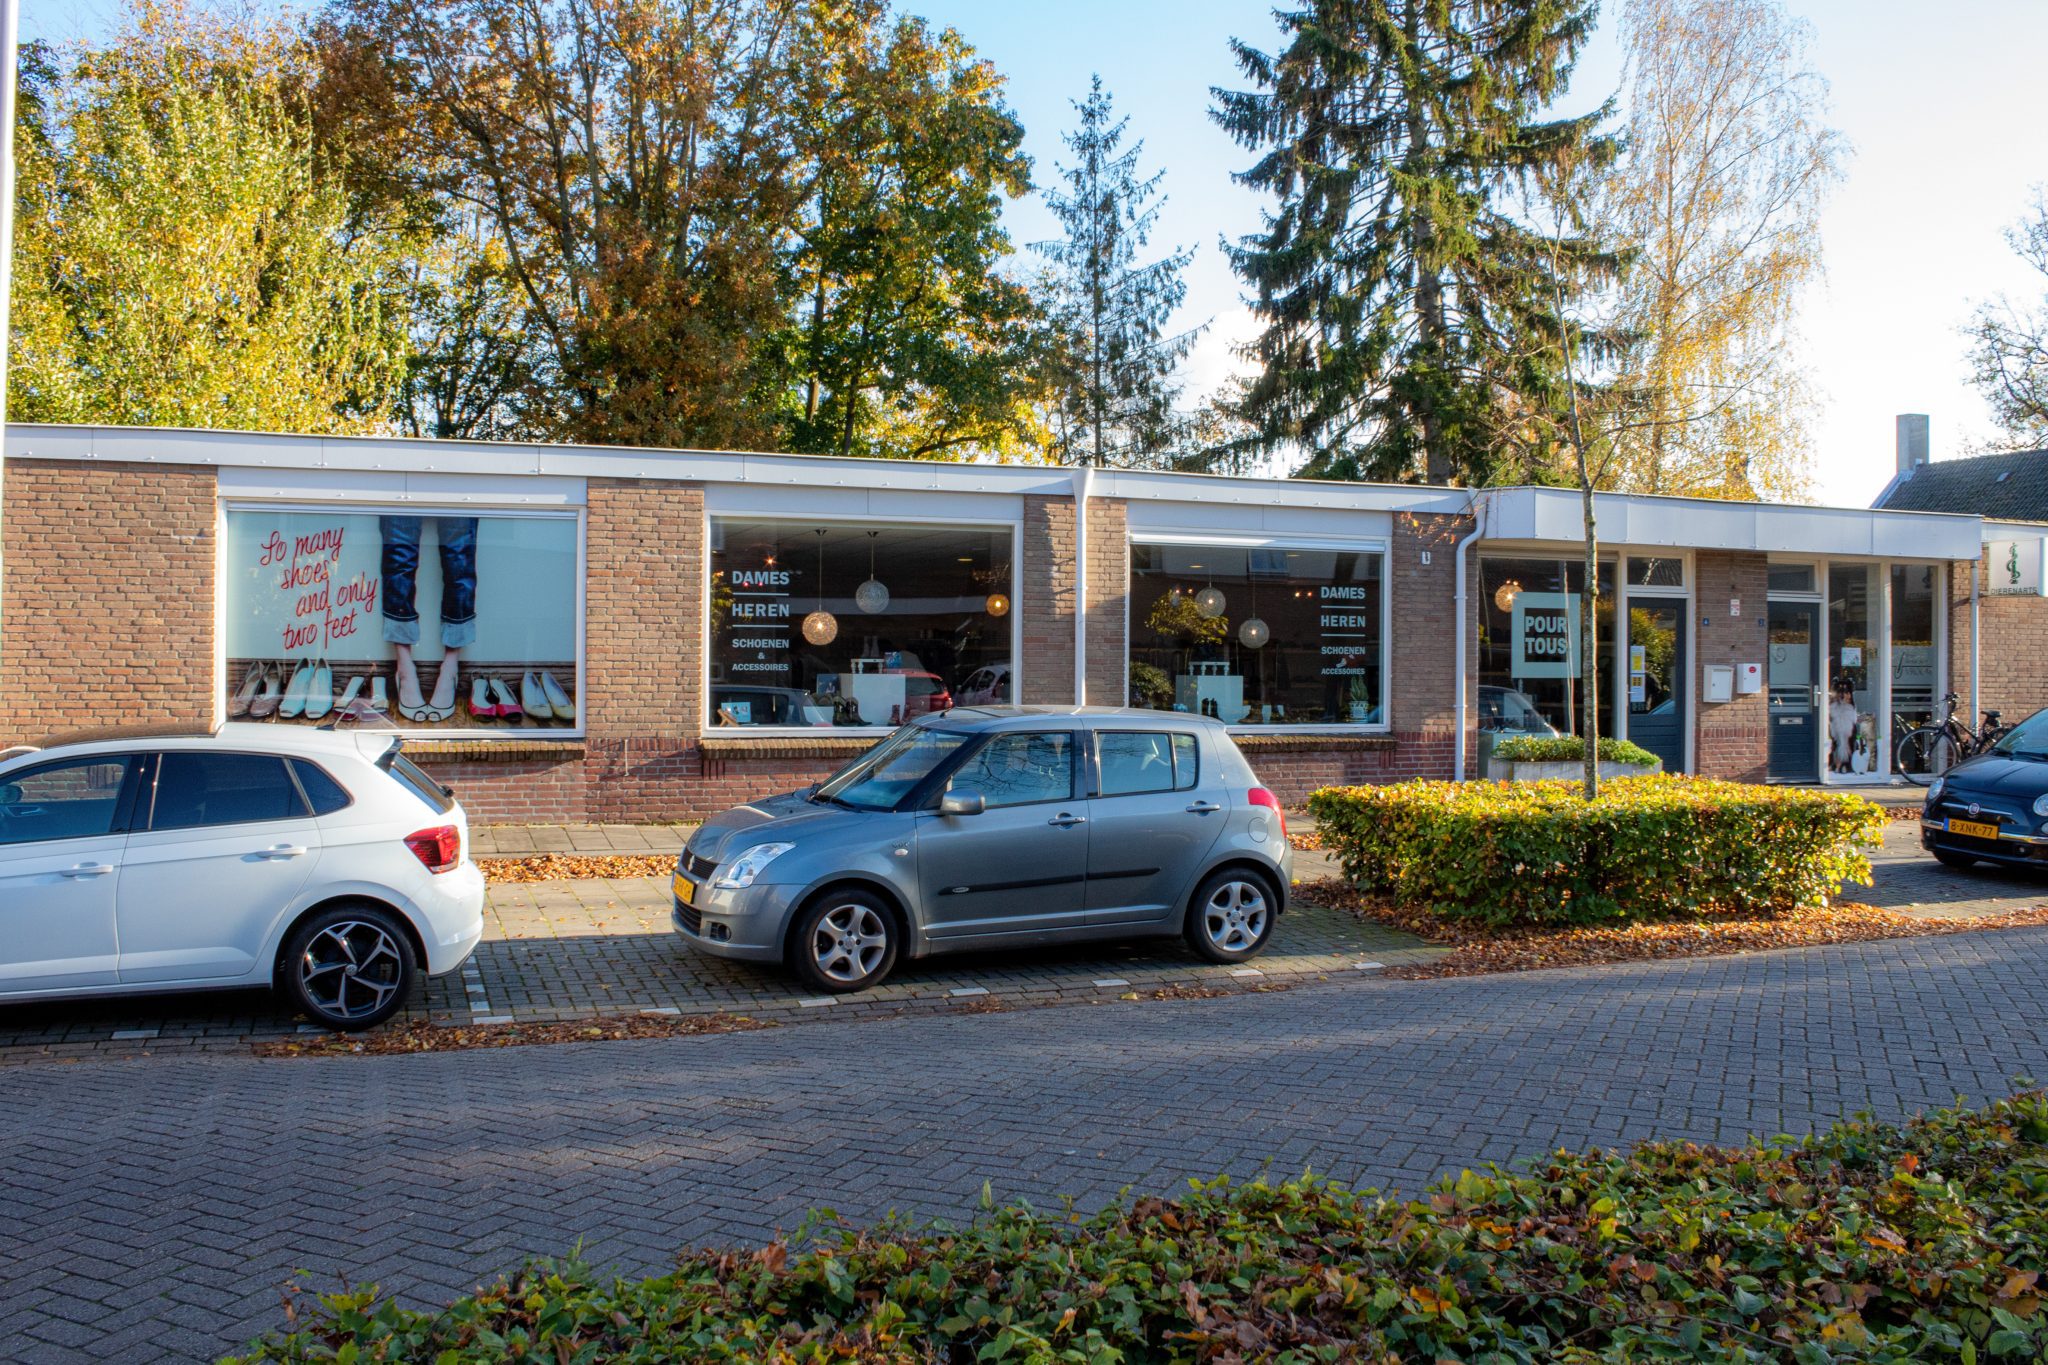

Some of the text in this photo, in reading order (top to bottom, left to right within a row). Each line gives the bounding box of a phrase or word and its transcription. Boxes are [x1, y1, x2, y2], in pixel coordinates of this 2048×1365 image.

[260, 527, 344, 565] So many
[281, 558, 329, 589] shoes
[732, 570, 790, 585] DAMES
[296, 571, 378, 616] and only
[1320, 586, 1366, 600] DAMES
[1990, 586, 2038, 595] DIERENARTS
[732, 603, 790, 617] HEREN
[1320, 615, 1366, 628] HEREN
[1525, 616, 1567, 633] POUR
[283, 608, 358, 650] two feet
[732, 638, 789, 649] SCHOENEN
[1321, 646, 1366, 655] SCHOENEN
[1525, 637, 1567, 654] TOUS
[758, 652, 765, 660] &
[732, 663, 789, 671] ACCESSOIRES
[1950, 821, 1993, 837] 8-XNK-77
